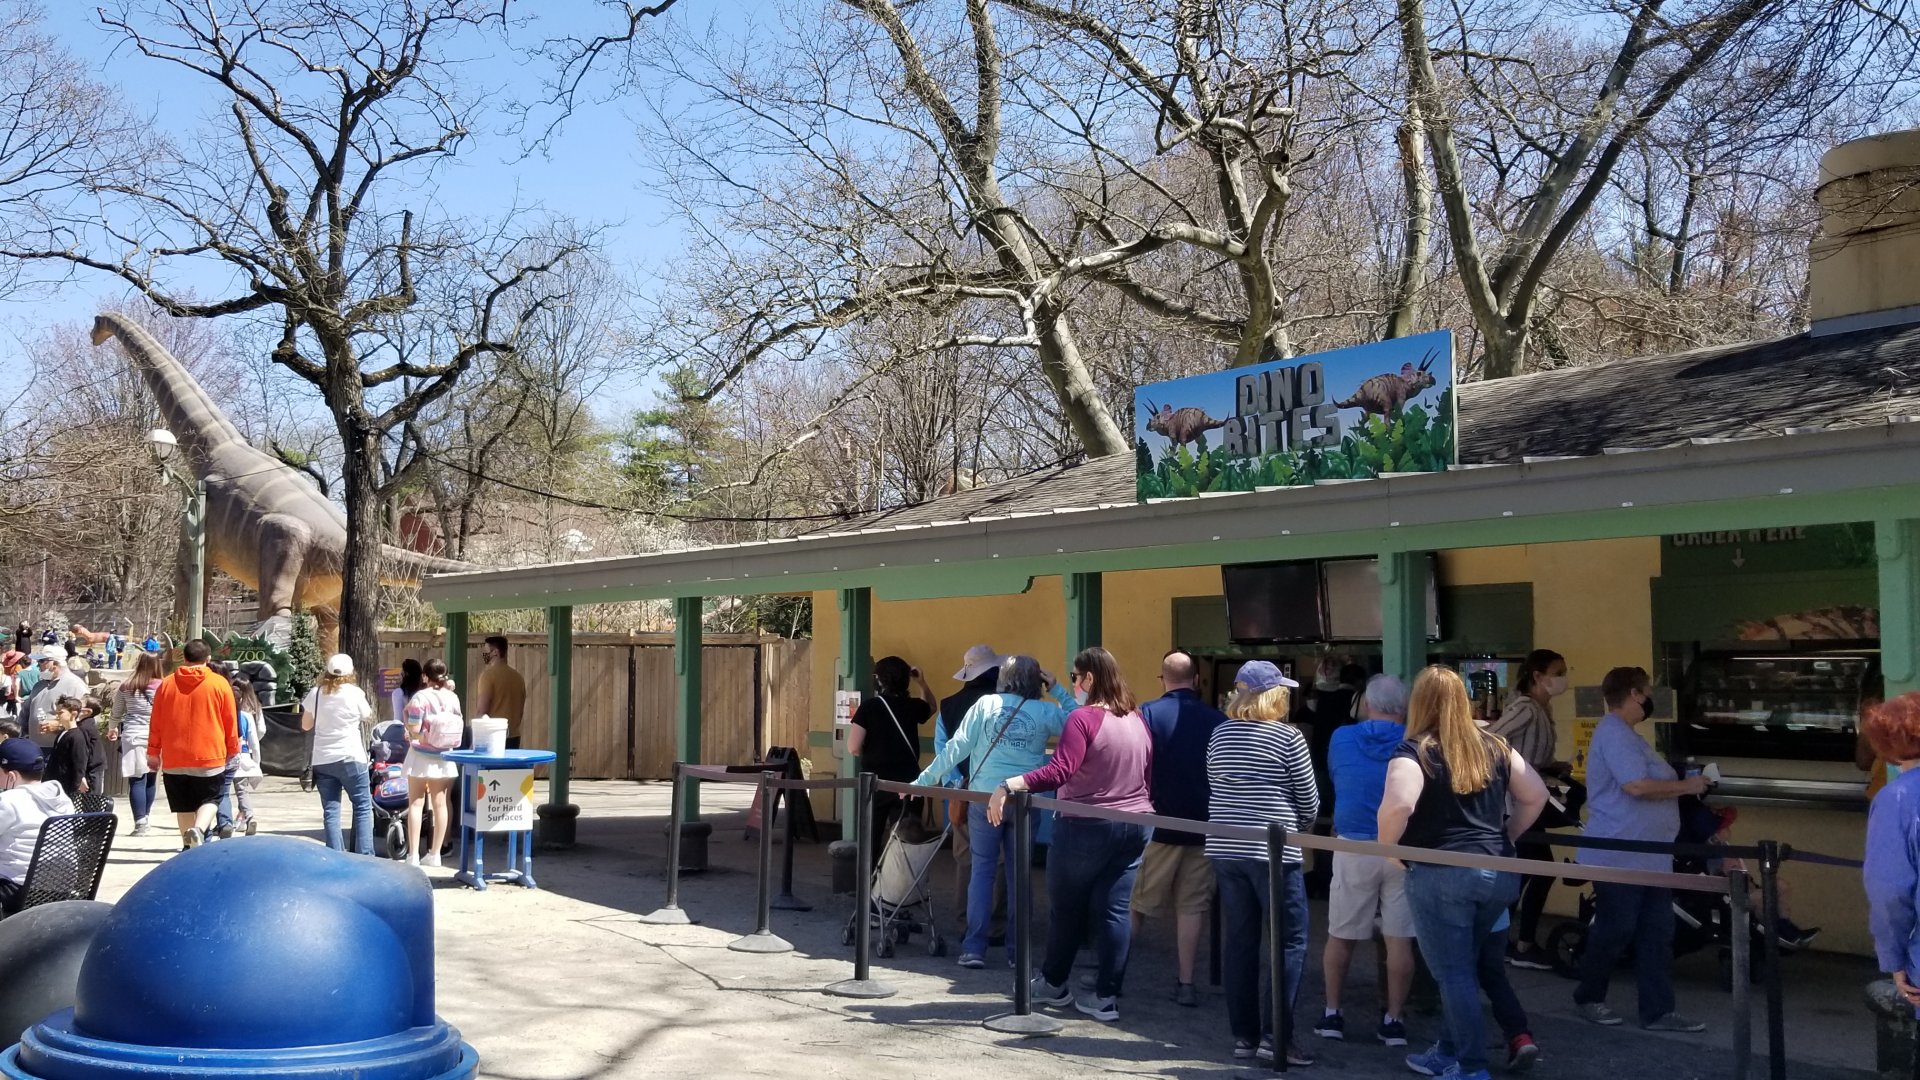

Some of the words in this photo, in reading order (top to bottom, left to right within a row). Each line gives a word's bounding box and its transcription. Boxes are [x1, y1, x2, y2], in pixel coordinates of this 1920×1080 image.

[1235, 362, 1325, 417] DINO
[1223, 405, 1341, 457] BITES
[236, 650, 266, 661] ZOO
[488, 795, 513, 804] Wipes
[488, 804, 500, 812] for
[503, 804, 522, 812] Hard
[488, 813, 523, 821] Surfaces
